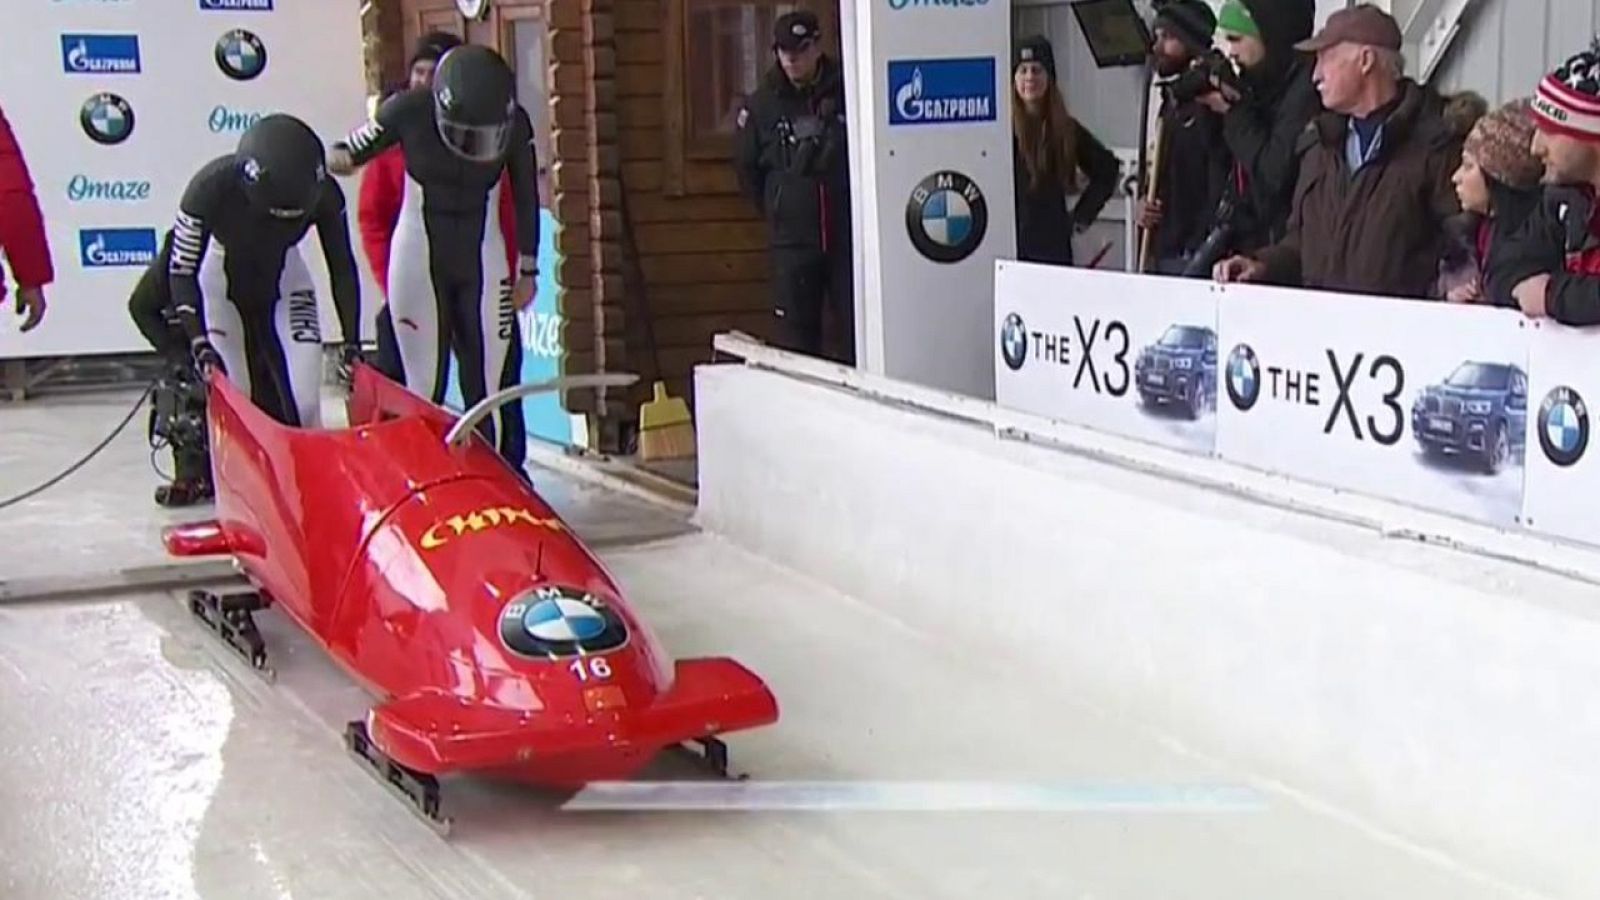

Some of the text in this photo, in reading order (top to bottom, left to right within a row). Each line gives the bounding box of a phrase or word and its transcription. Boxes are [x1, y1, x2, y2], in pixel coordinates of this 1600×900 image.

[924, 97, 989, 119] GAZPROM
[67, 174, 151, 200] Omaze
[913, 174, 979, 204] BMW
[290, 290, 322, 344] CHINA
[1031, 315, 1131, 397] THE X3
[1267, 349, 1405, 446] THE X3
[569, 657, 612, 682] 16
